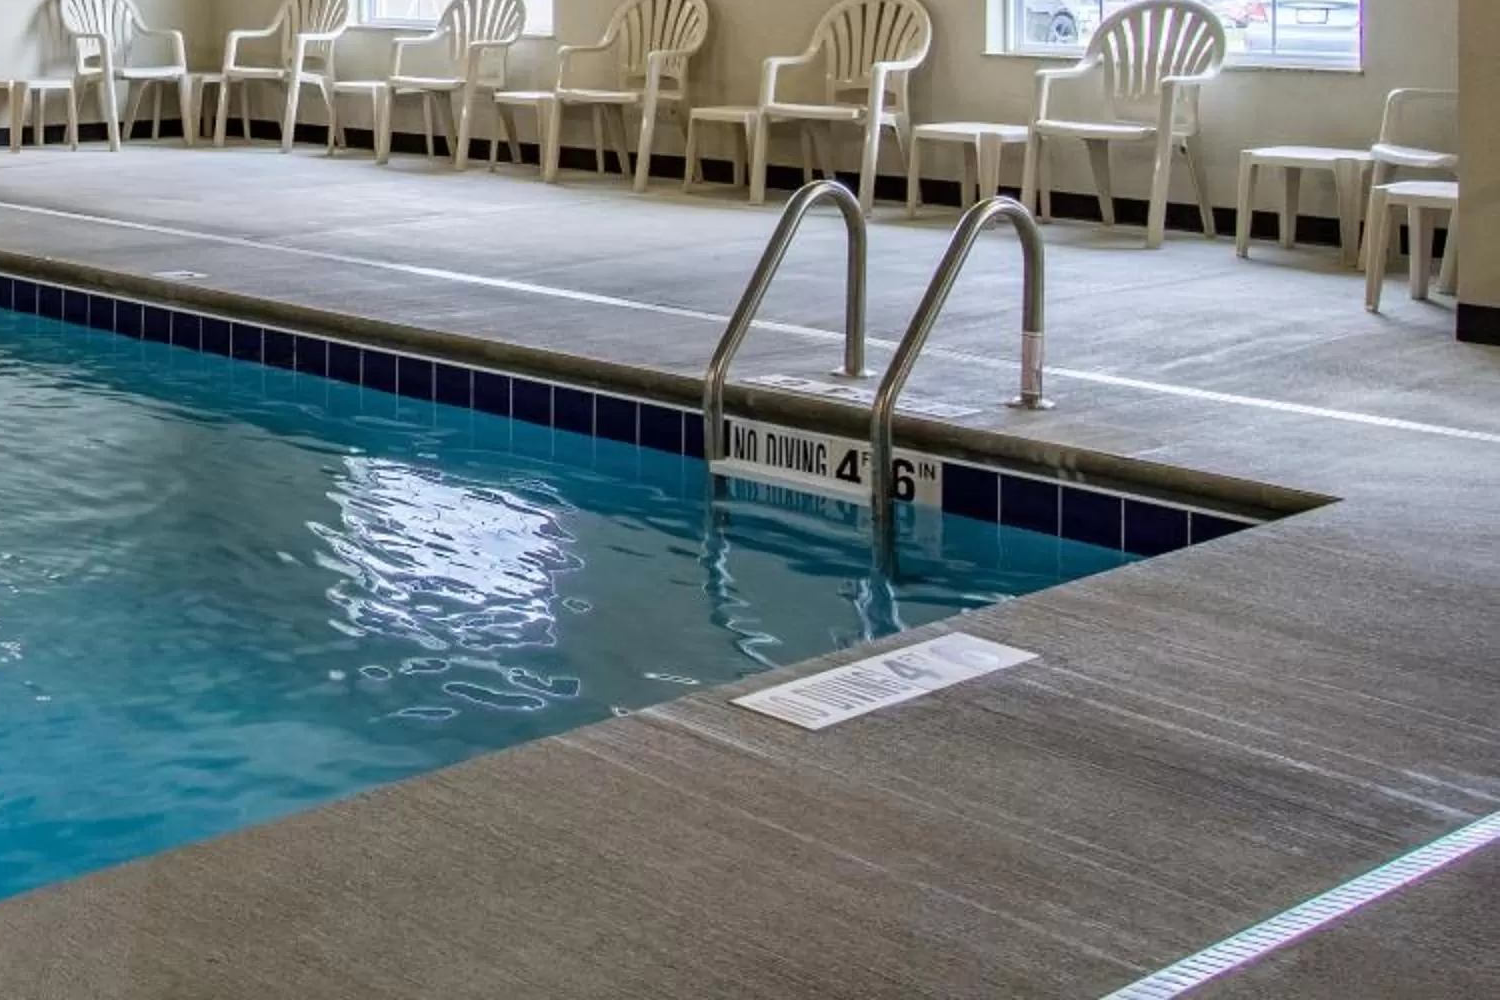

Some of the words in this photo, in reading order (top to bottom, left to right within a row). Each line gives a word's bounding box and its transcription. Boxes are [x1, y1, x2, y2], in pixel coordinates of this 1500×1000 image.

[734, 426, 757, 463] NO
[766, 433, 828, 477] DIVING
[835, 449, 861, 484] 4
[891, 458, 916, 502] 6
[919, 462, 936, 481] IN
